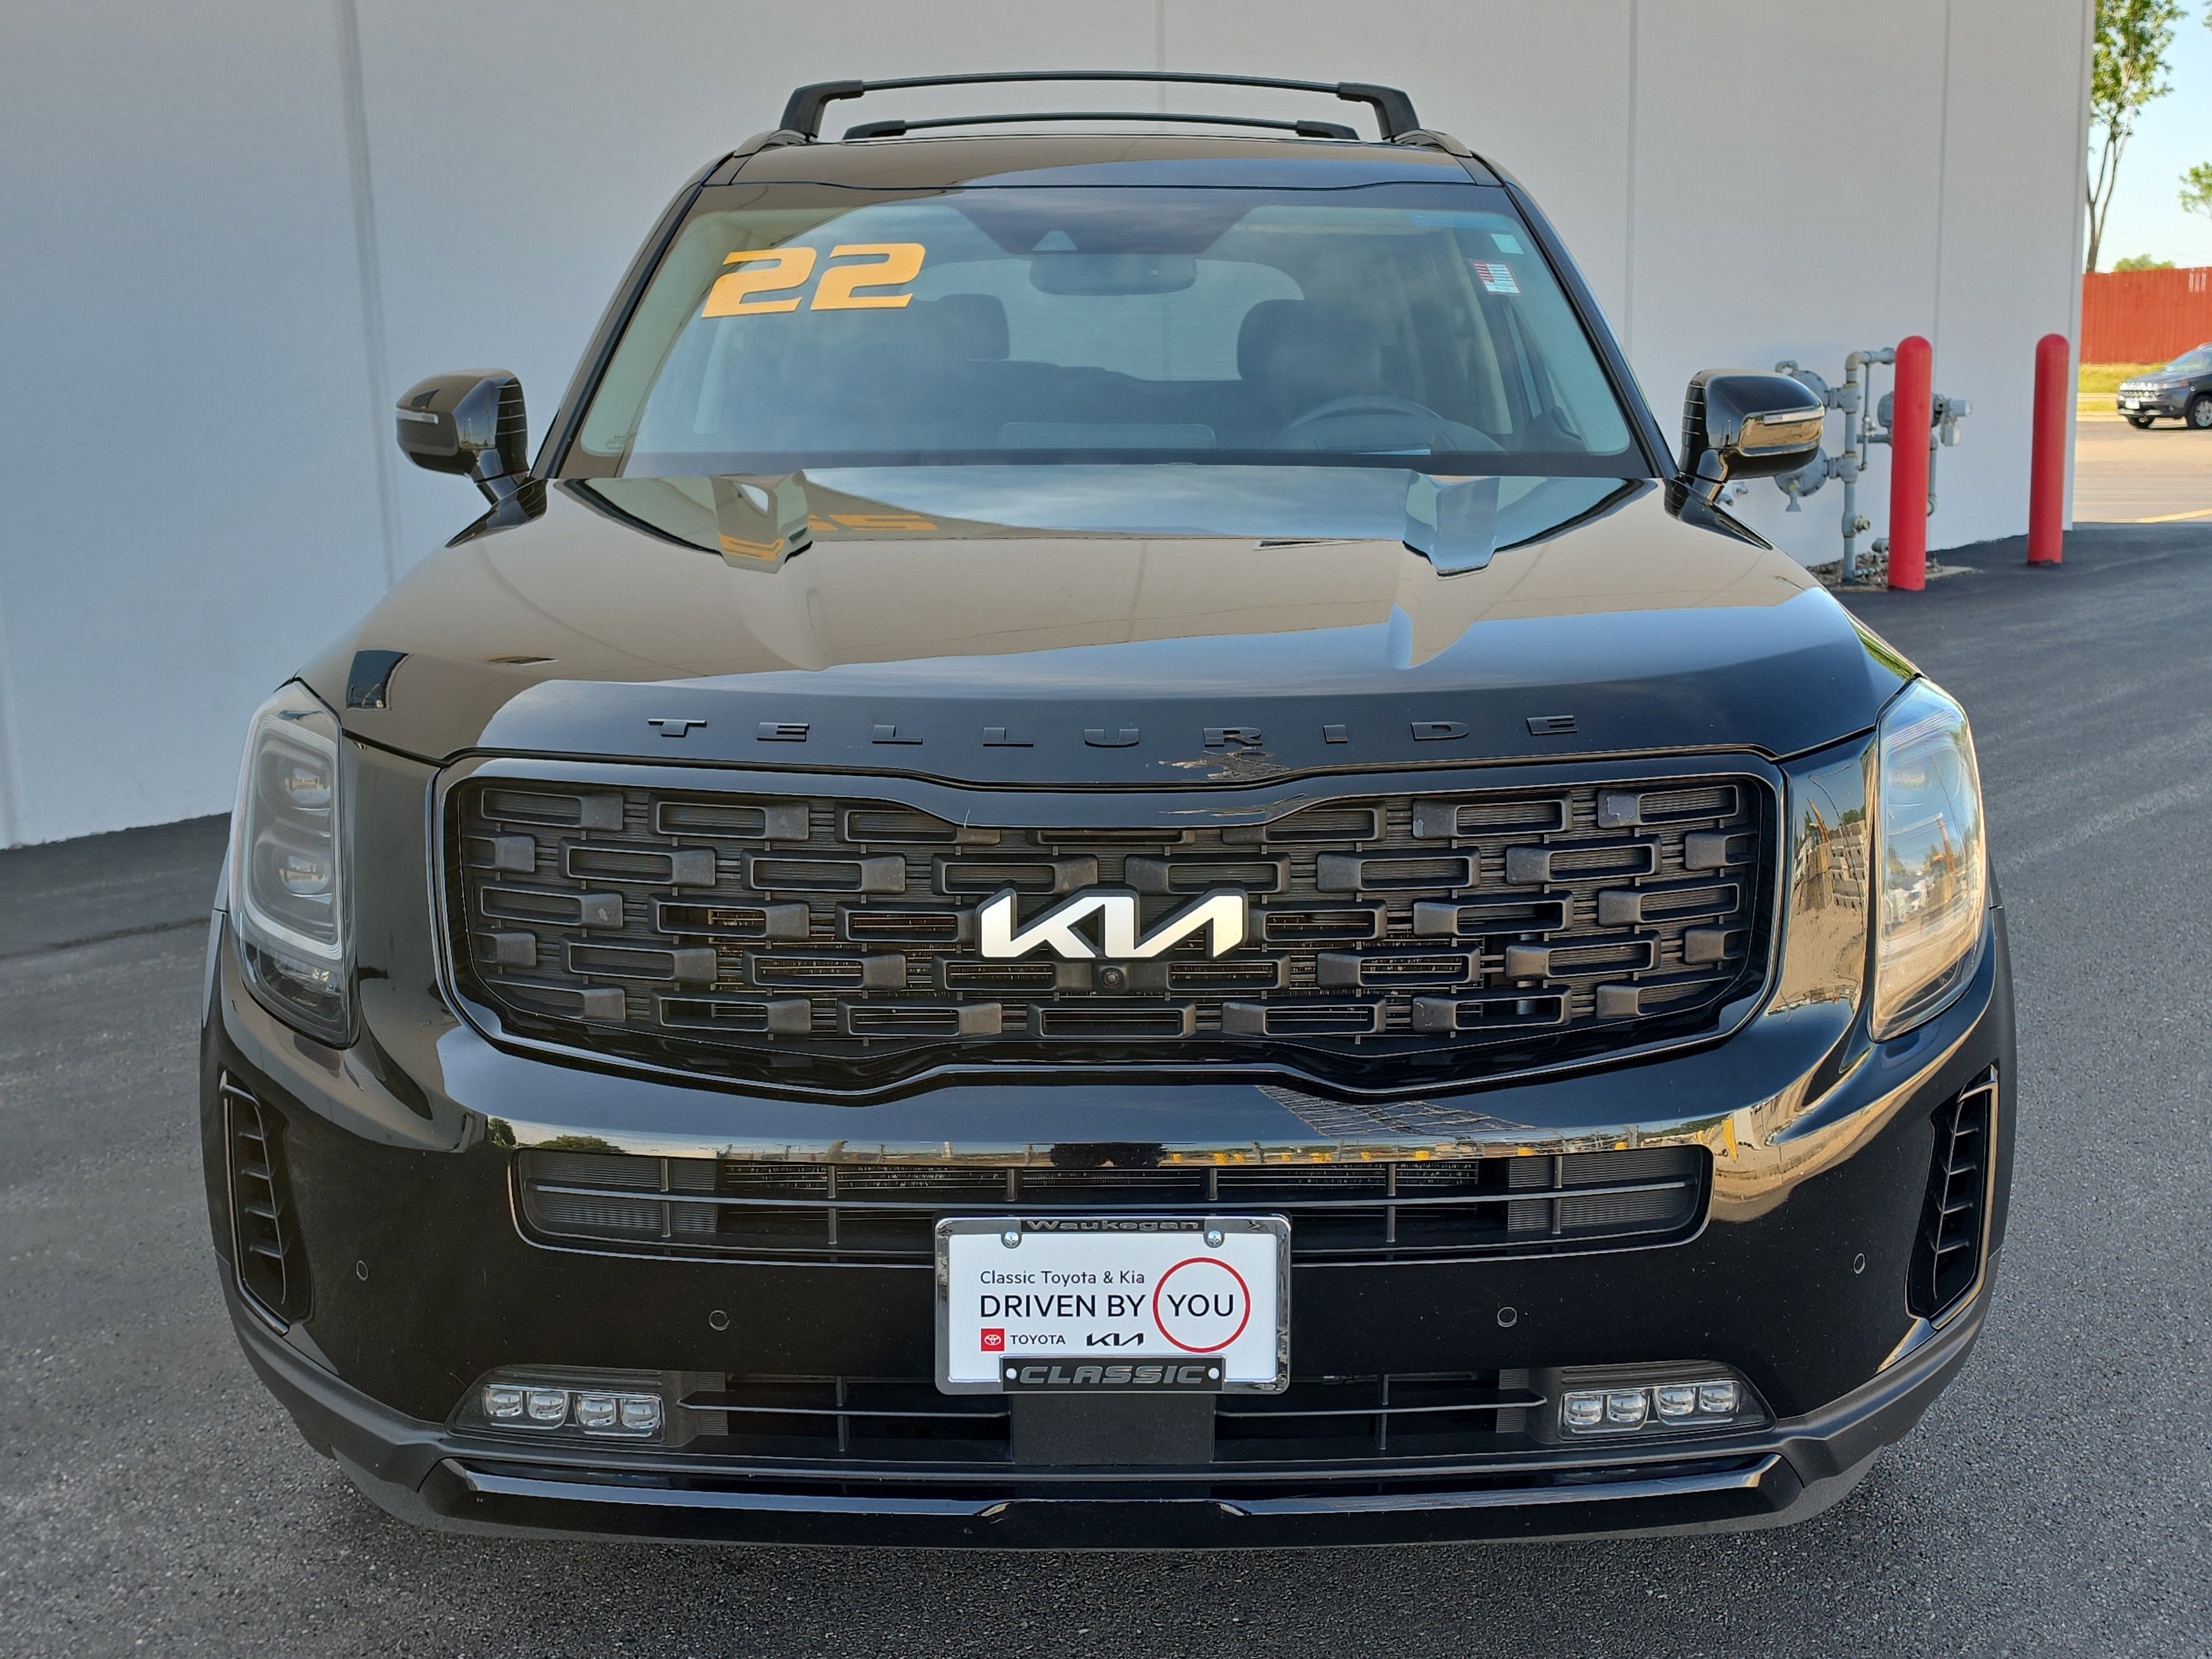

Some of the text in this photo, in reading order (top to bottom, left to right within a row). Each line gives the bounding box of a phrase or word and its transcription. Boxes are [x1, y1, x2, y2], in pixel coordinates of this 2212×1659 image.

[700, 243, 926, 318] 22
[647, 714, 1579, 748] TELLURIDE
[1026, 1220, 1199, 1231] Waukegan
[980, 1271, 1145, 1288] Classic Toyota & Kia
[980, 1294, 1234, 1317] DRIVEN BY YOU
[1010, 1334, 1066, 1345] TOYOTA
[1019, 1365, 1206, 1384] CLASSIC
